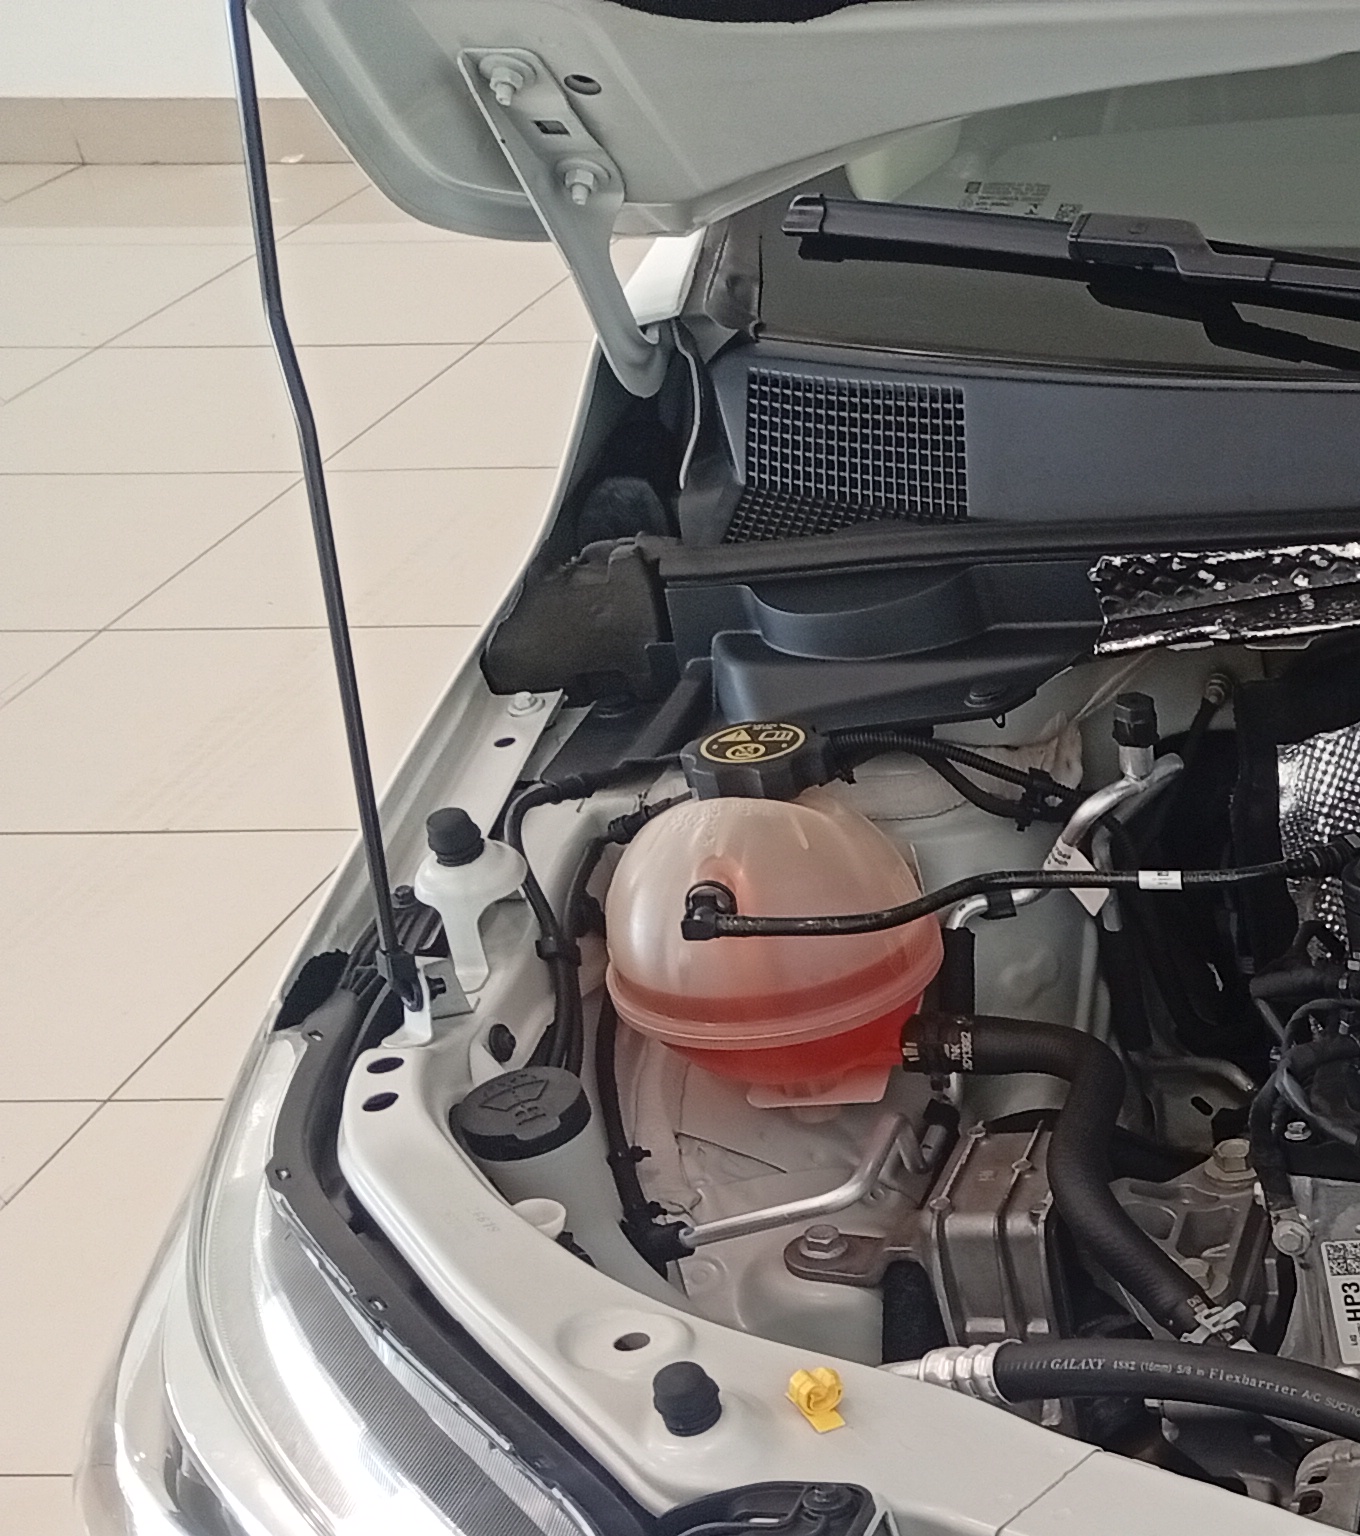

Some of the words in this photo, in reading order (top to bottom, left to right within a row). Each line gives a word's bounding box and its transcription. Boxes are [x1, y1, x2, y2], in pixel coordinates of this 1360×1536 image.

[1050, 1357, 1106, 1371] GALAXY
[1176, 1364, 1192, 1375] 5/8
[1208, 1367, 1298, 1397] Flexbarrier
[1301, 1389, 1321, 1403] A/C
